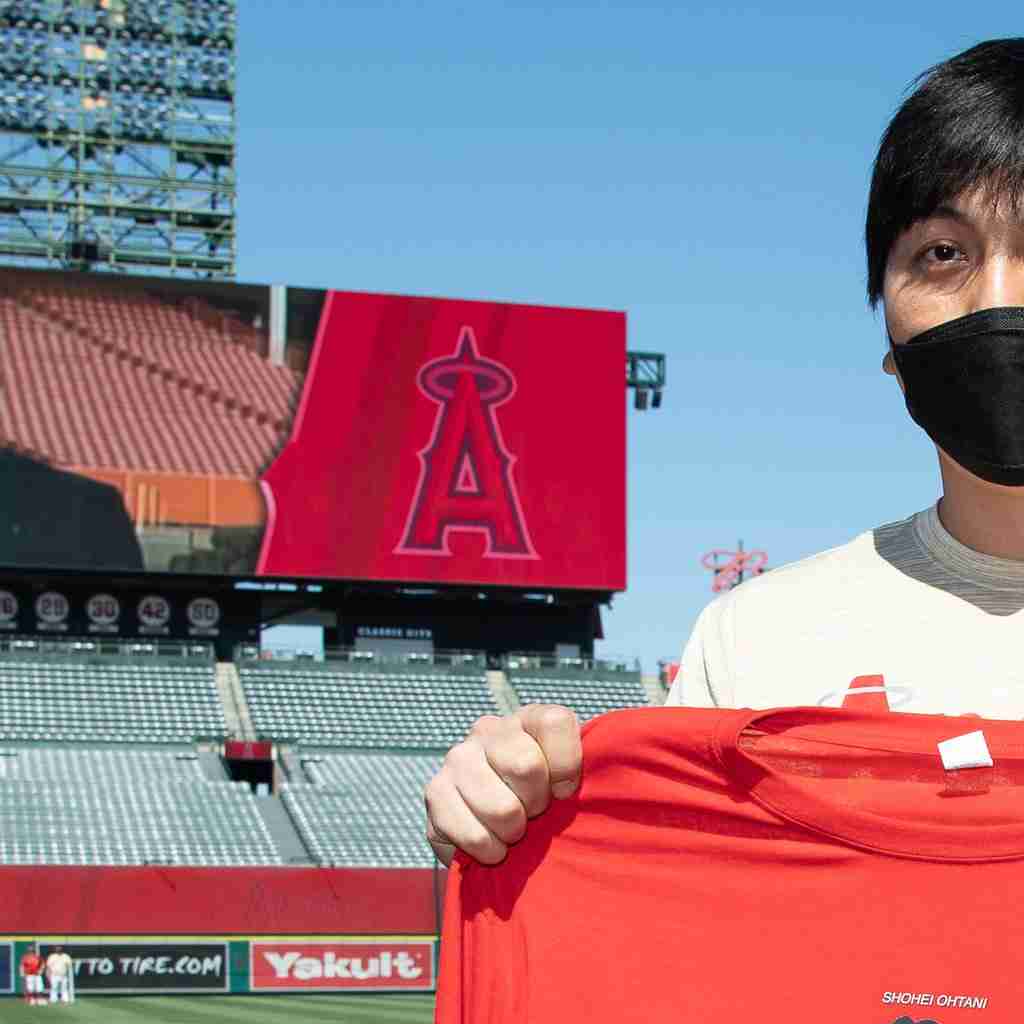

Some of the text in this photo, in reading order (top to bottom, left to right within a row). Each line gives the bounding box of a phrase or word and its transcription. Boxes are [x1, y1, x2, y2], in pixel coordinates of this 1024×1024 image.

[394, 326, 542, 561] A
[142, 602, 166, 620] 42
[73, 955, 222, 977] TTO TIRE.COM
[264, 951, 423, 980] Yakult
[882, 991, 988, 1009] SHOHEI OHTANI
